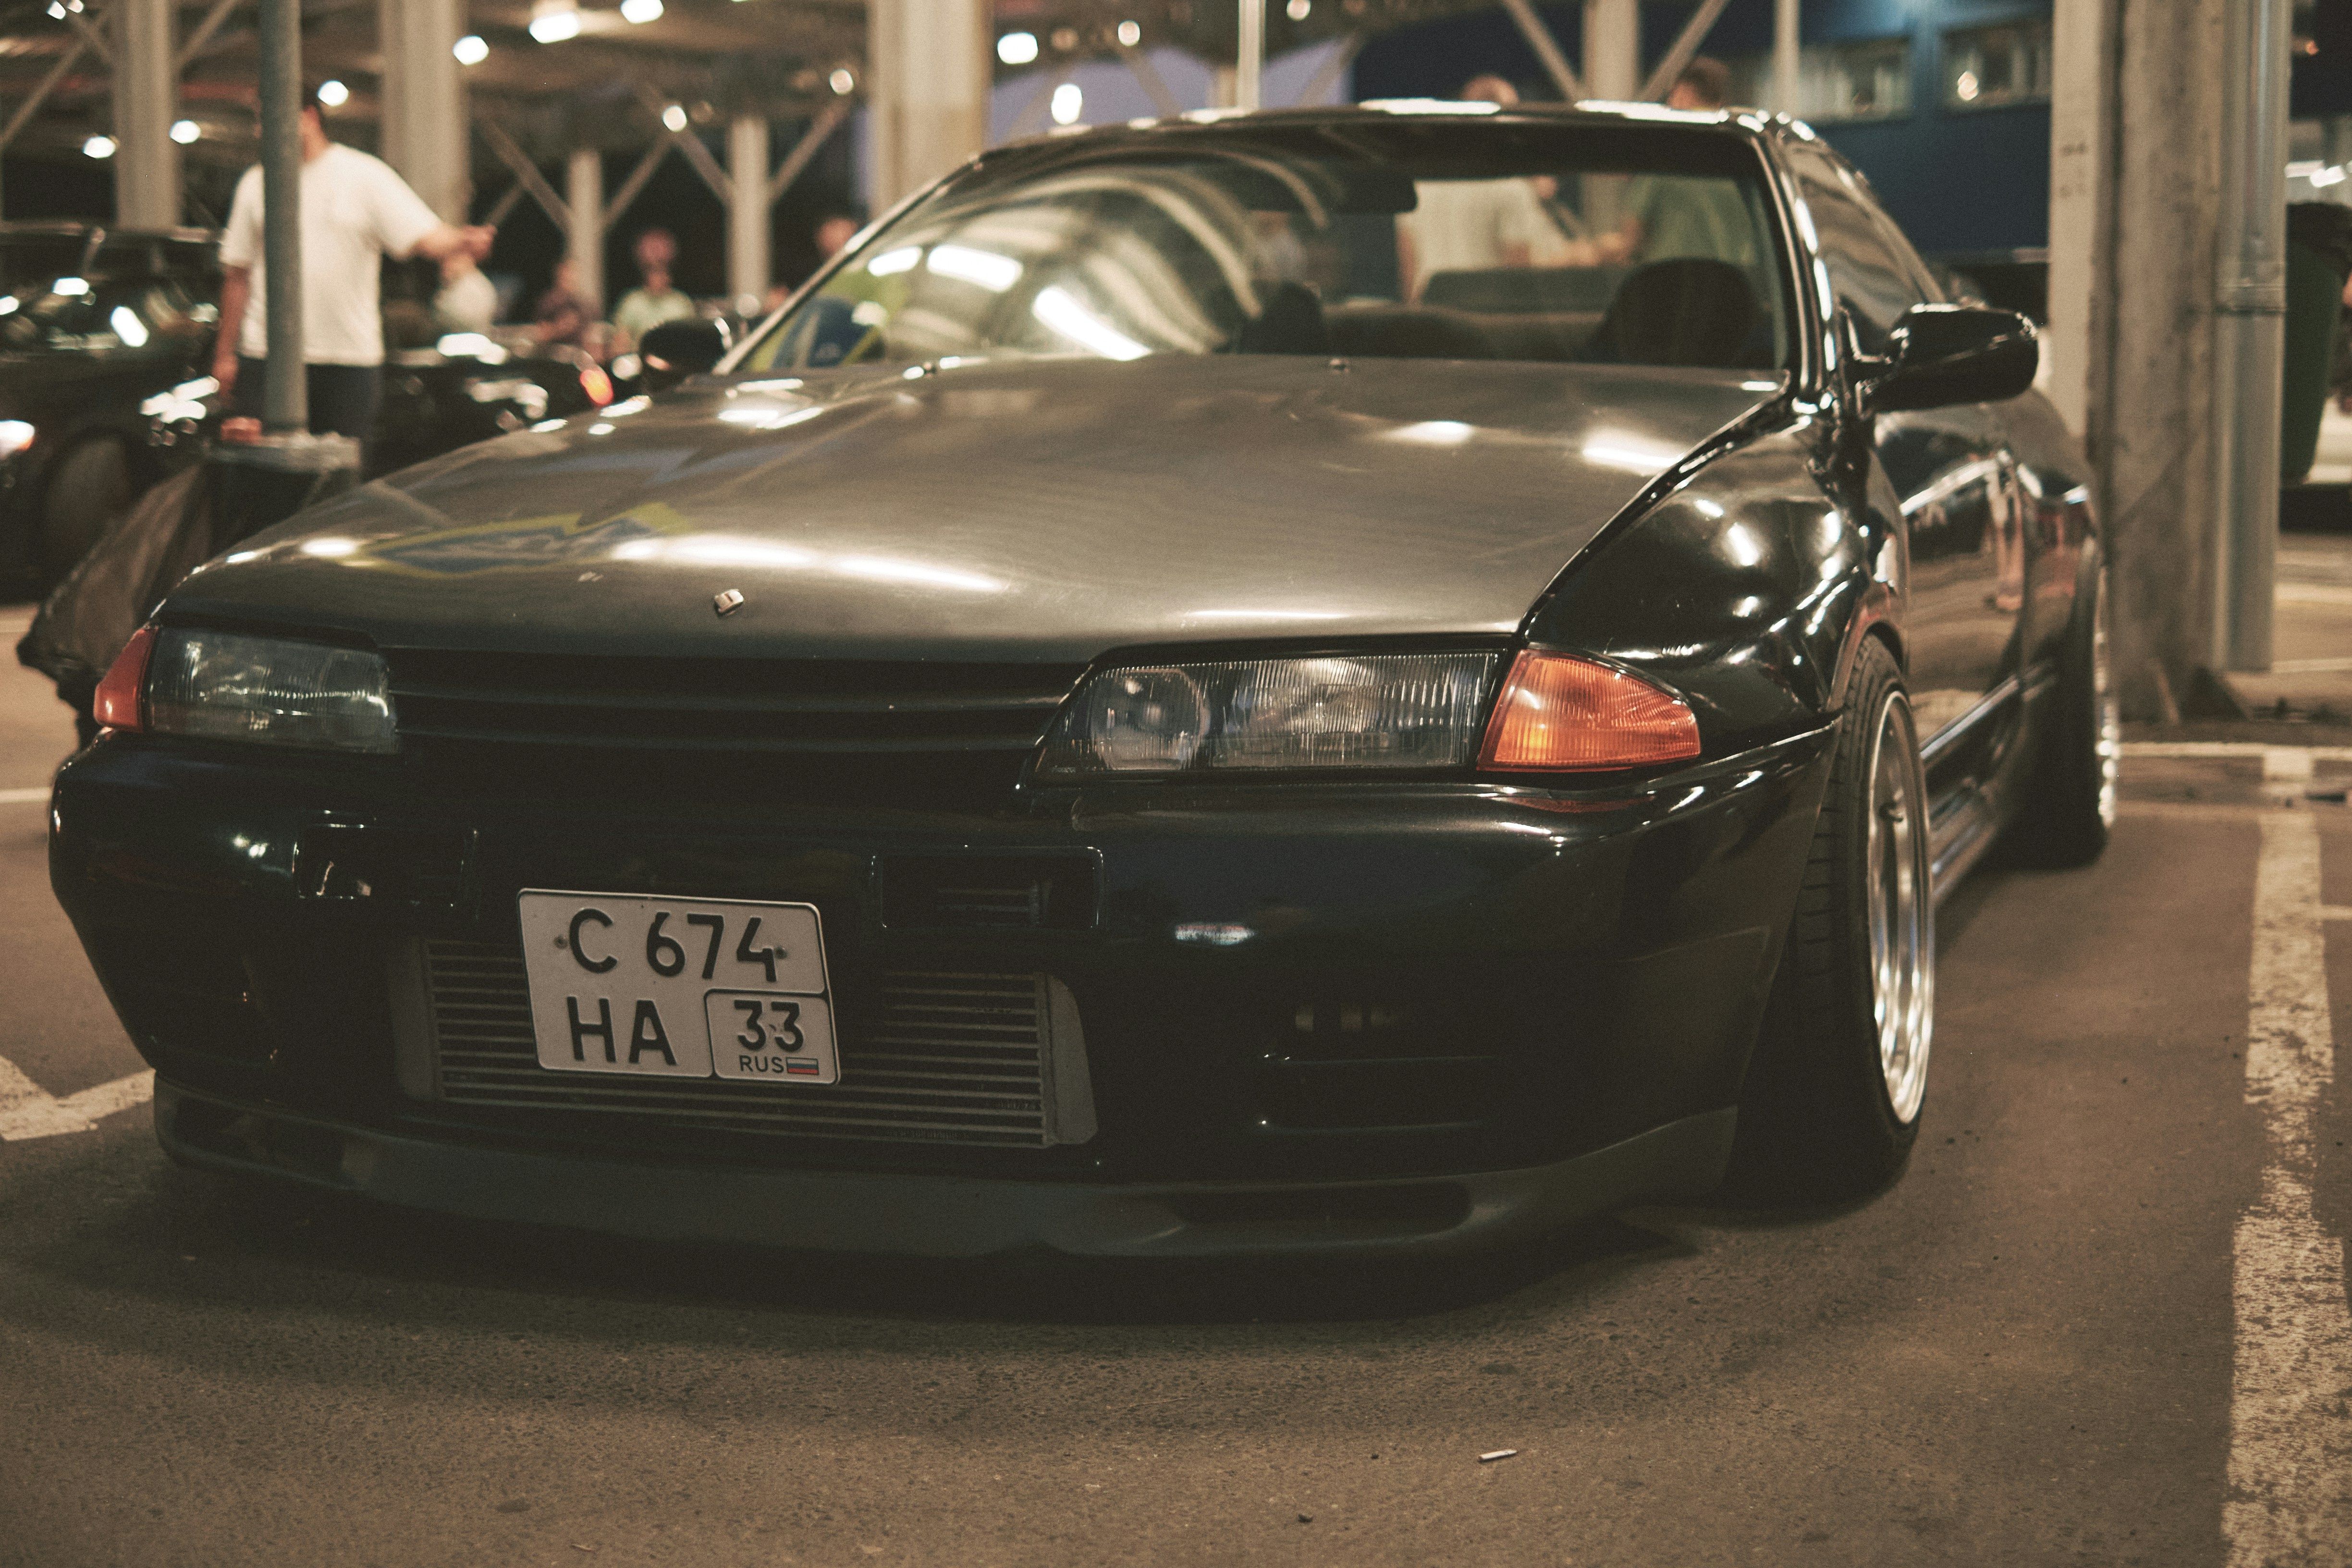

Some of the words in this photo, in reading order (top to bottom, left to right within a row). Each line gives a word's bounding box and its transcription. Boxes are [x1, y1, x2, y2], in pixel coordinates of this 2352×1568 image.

[646, 912, 777, 983] 674
[734, 1000, 804, 1053] 33
[739, 1055, 784, 1074] RUS
